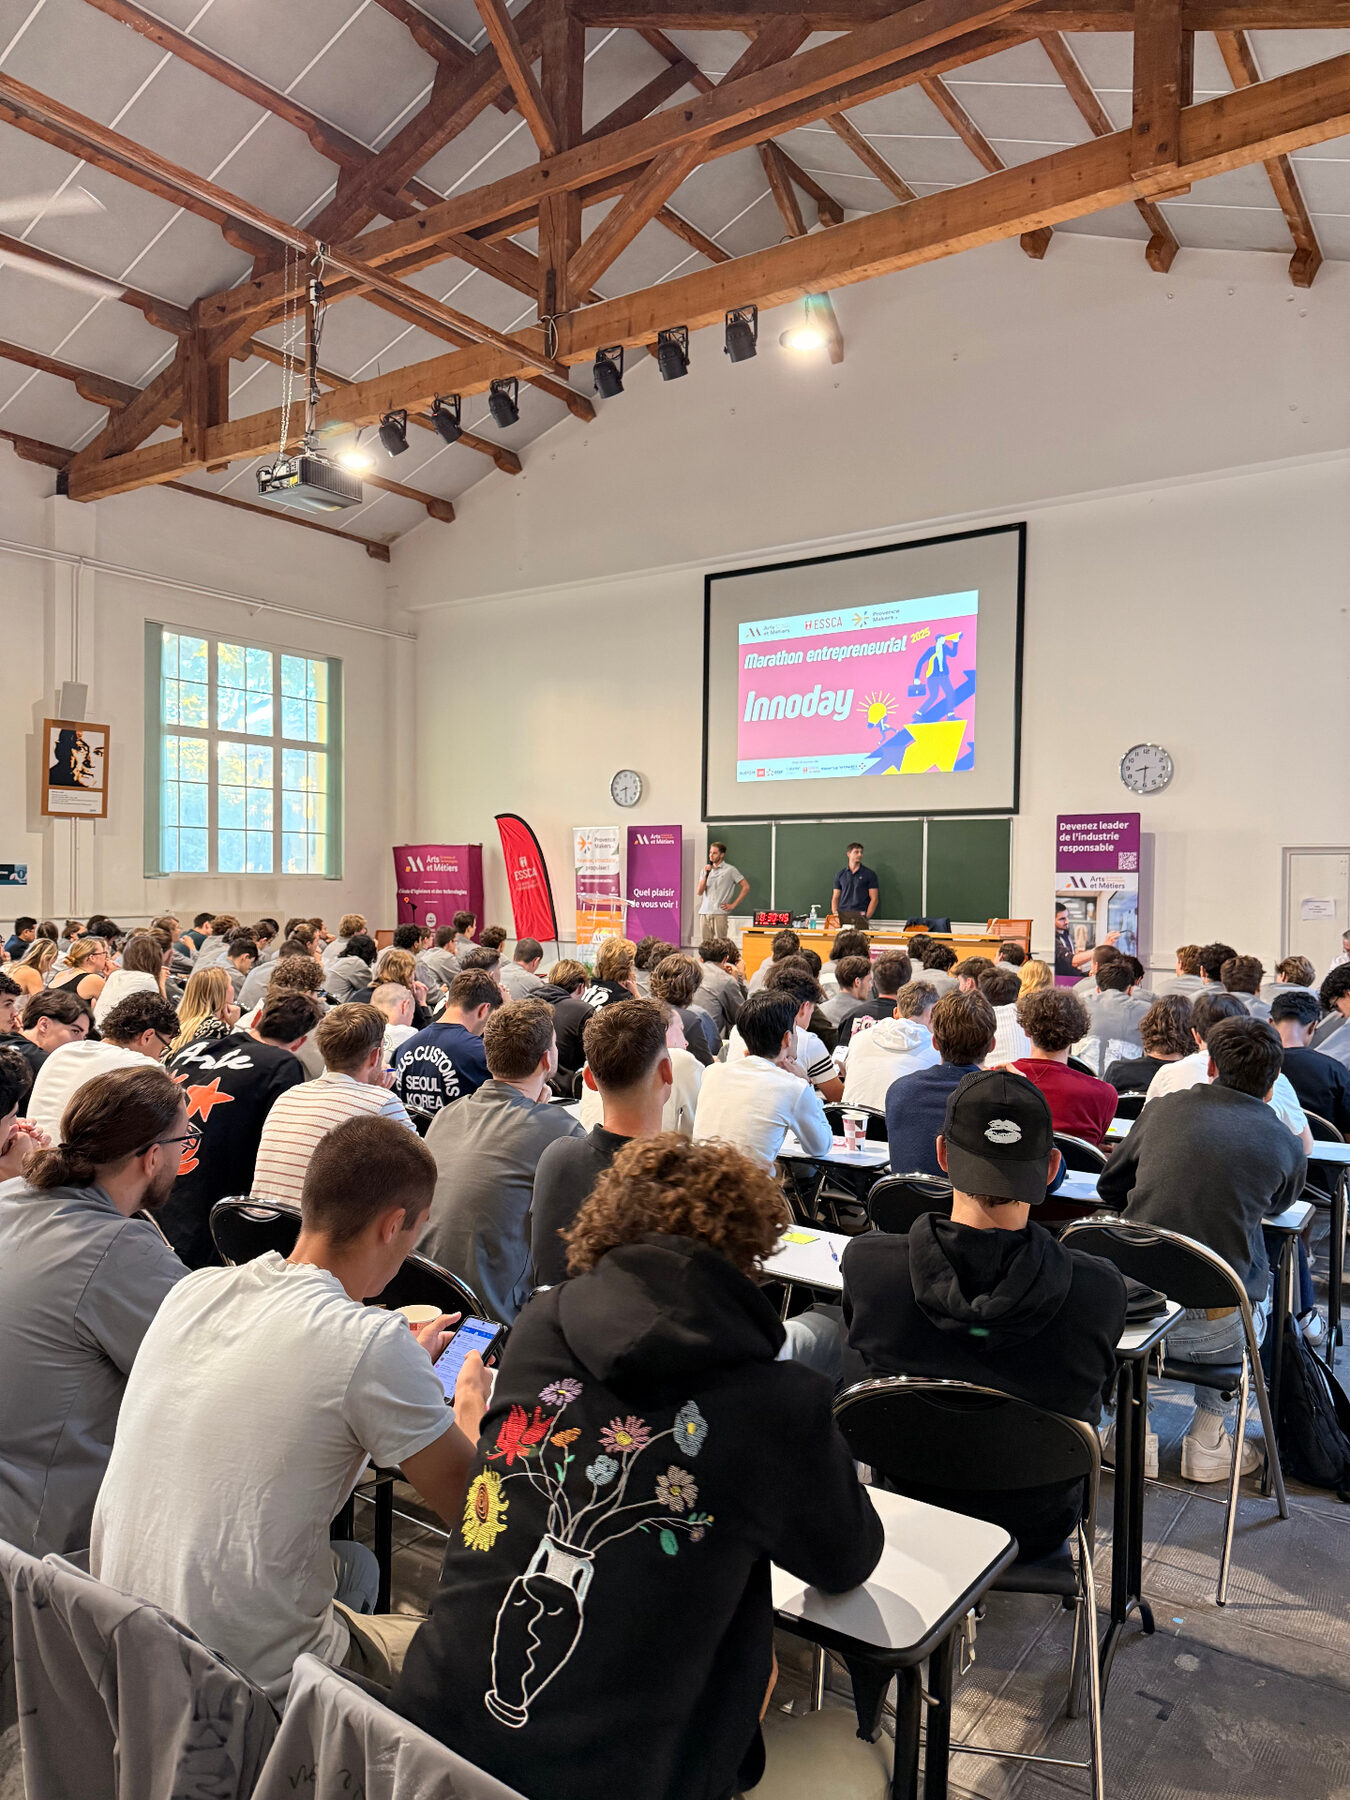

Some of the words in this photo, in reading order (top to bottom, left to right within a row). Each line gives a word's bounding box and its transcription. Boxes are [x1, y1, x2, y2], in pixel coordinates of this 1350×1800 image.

[813, 616, 843, 629] ESSCA
[744, 649, 803, 669] Marathon
[806, 635, 908, 662] entrepreneurial
[911, 627, 931, 644] 2025
[743, 684, 855, 722] Innoday
[1060, 822, 1098, 831] Devenez
[1099, 820, 1130, 829] leader
[1059, 832, 1071, 841] de
[1072, 831, 1120, 841] l'industrie
[1059, 842, 1115, 853] responsable
[426, 854, 440, 863] Arts
[426, 864, 433, 872] et
[434, 862, 458, 872] Métiers
[514, 867, 537, 881] ESSCA
[1098, 881, 1126, 889] Métiers
[633, 888, 651, 898] Quel
[651, 888, 675, 899] plaisir
[641, 901, 658, 909] vous
[659, 900, 675, 909] voir
[414, 1045, 460, 1097] CUSTOMS
[405, 1075, 441, 1092] SEOUL
[406, 1092, 444, 1109] KOREA
